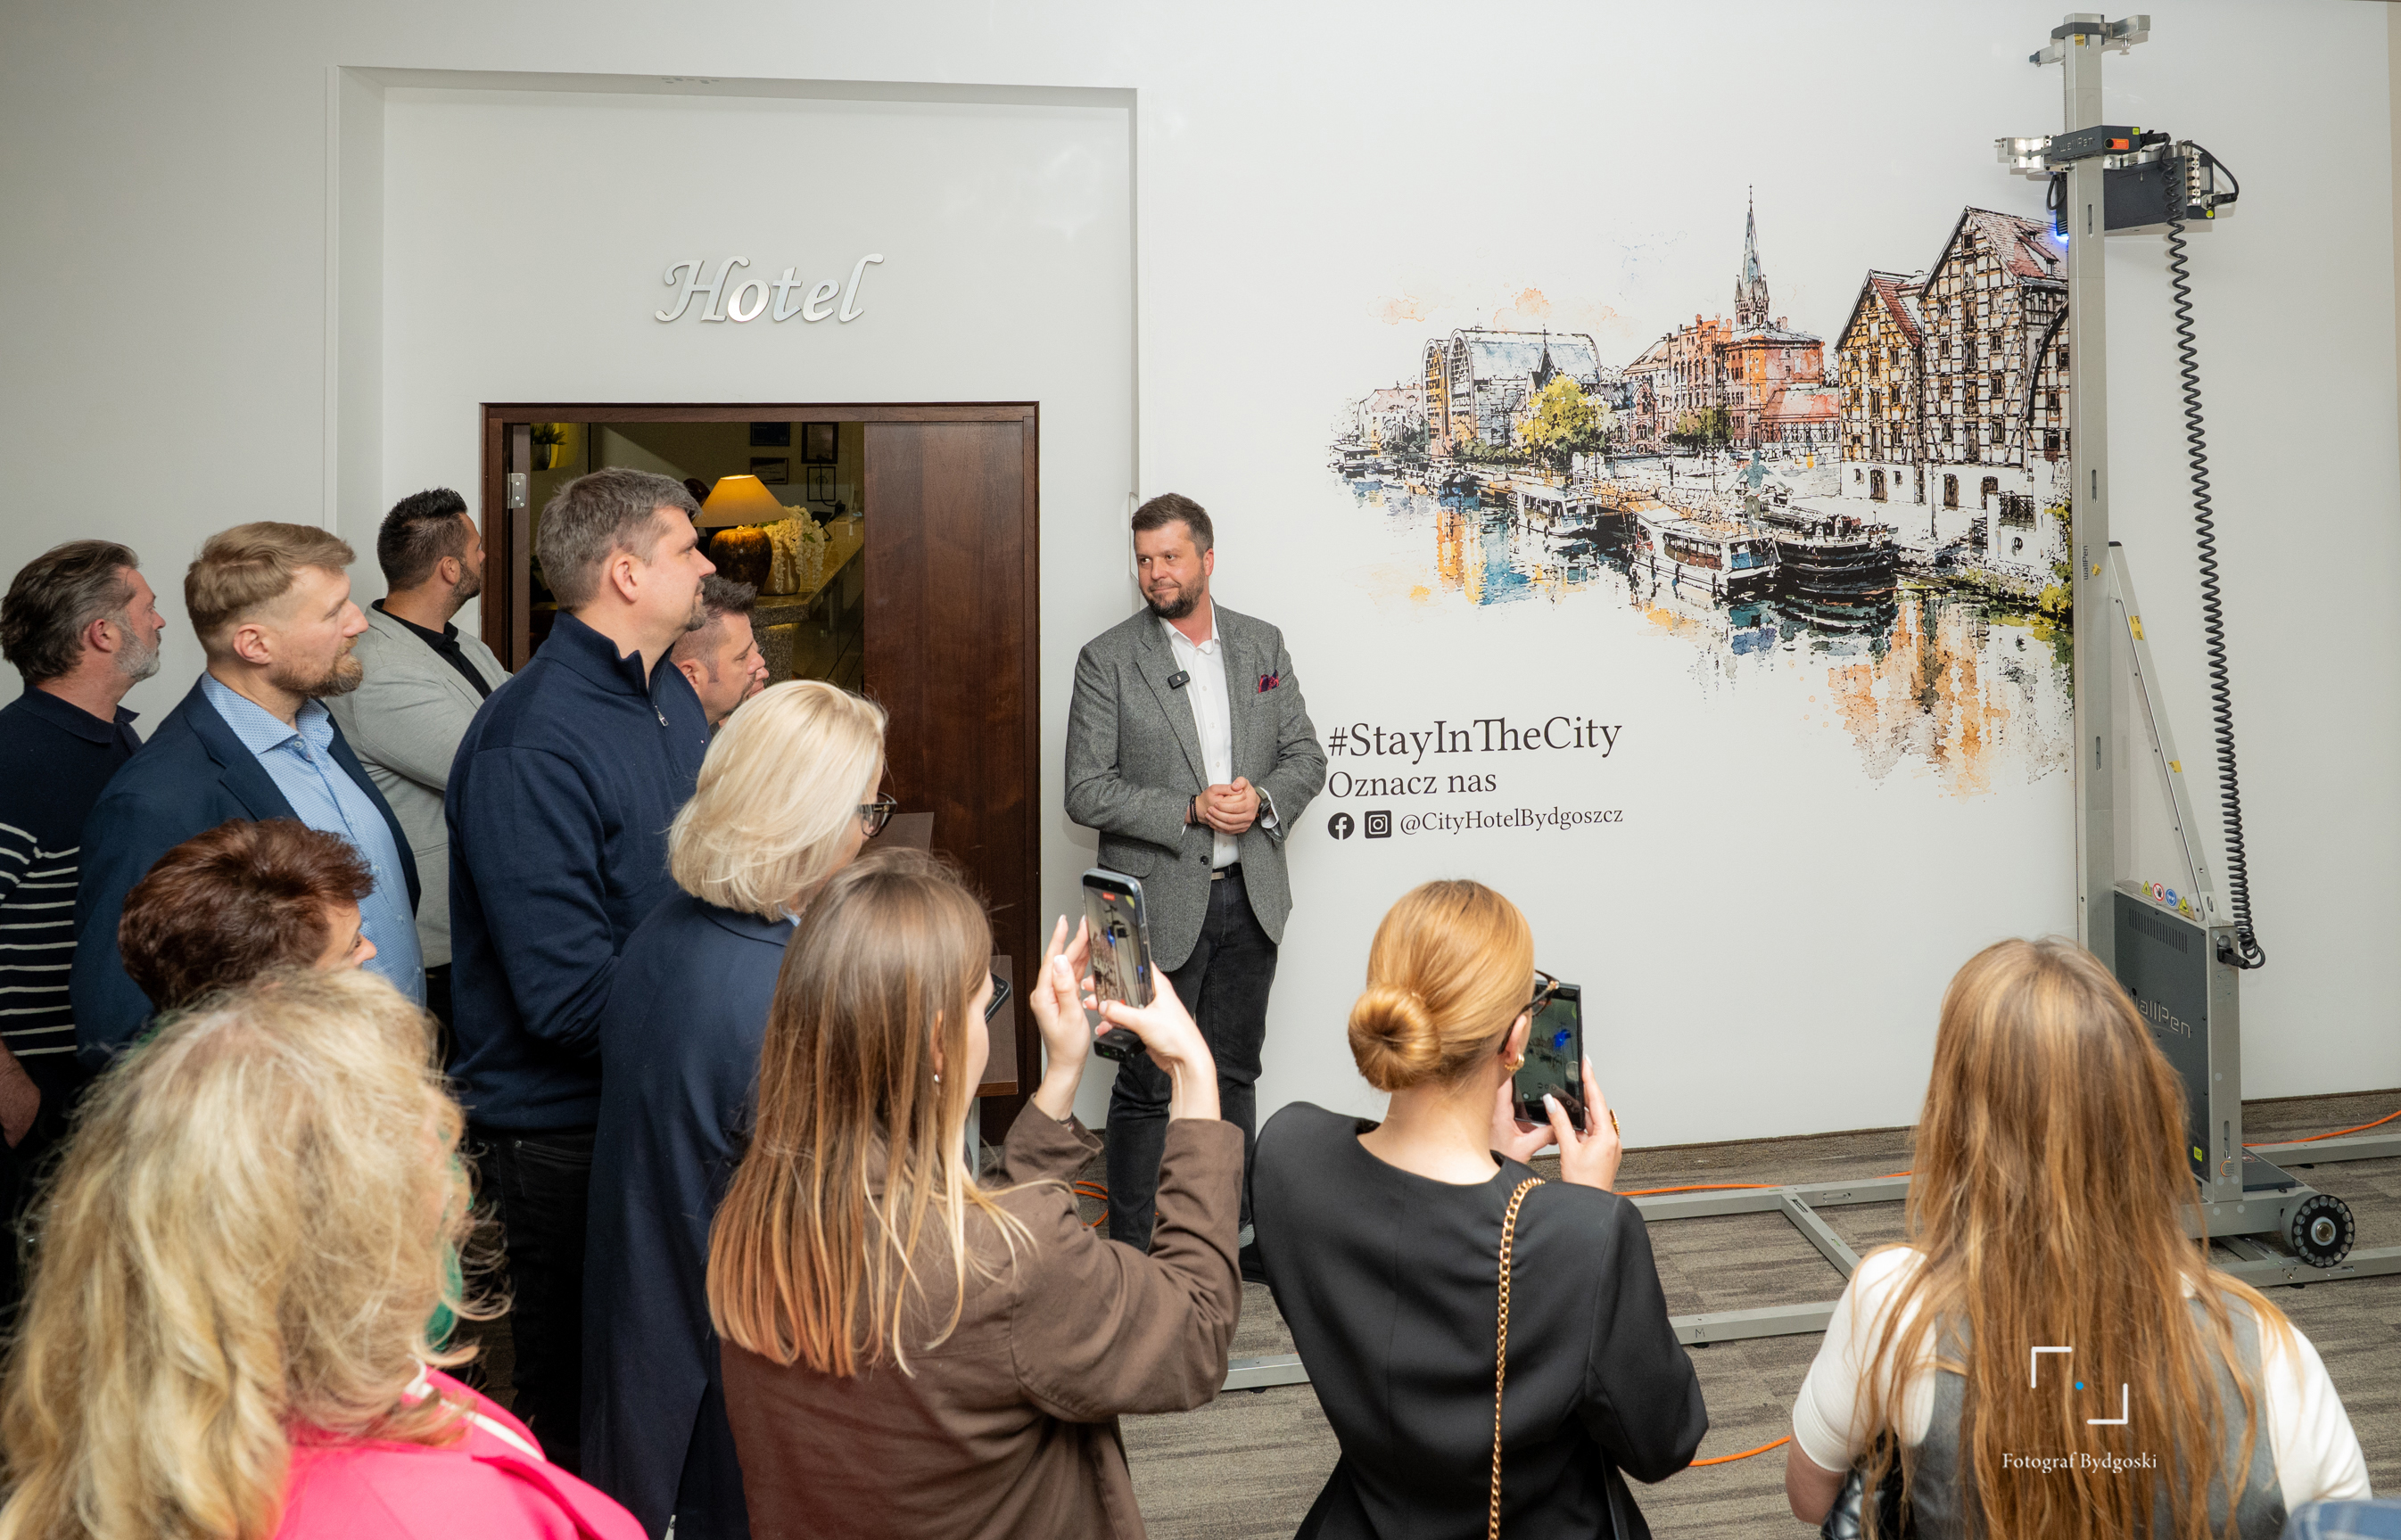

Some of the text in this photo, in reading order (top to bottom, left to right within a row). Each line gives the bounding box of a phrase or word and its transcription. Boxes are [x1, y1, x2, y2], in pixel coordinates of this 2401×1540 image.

[655, 253, 885, 323] Hotel
[1328, 716, 1622, 765] #StayInTheCity
[1328, 770, 1498, 798] Oznacz nas
[1399, 806, 1623, 836] @CityHotelBydgoszcz
